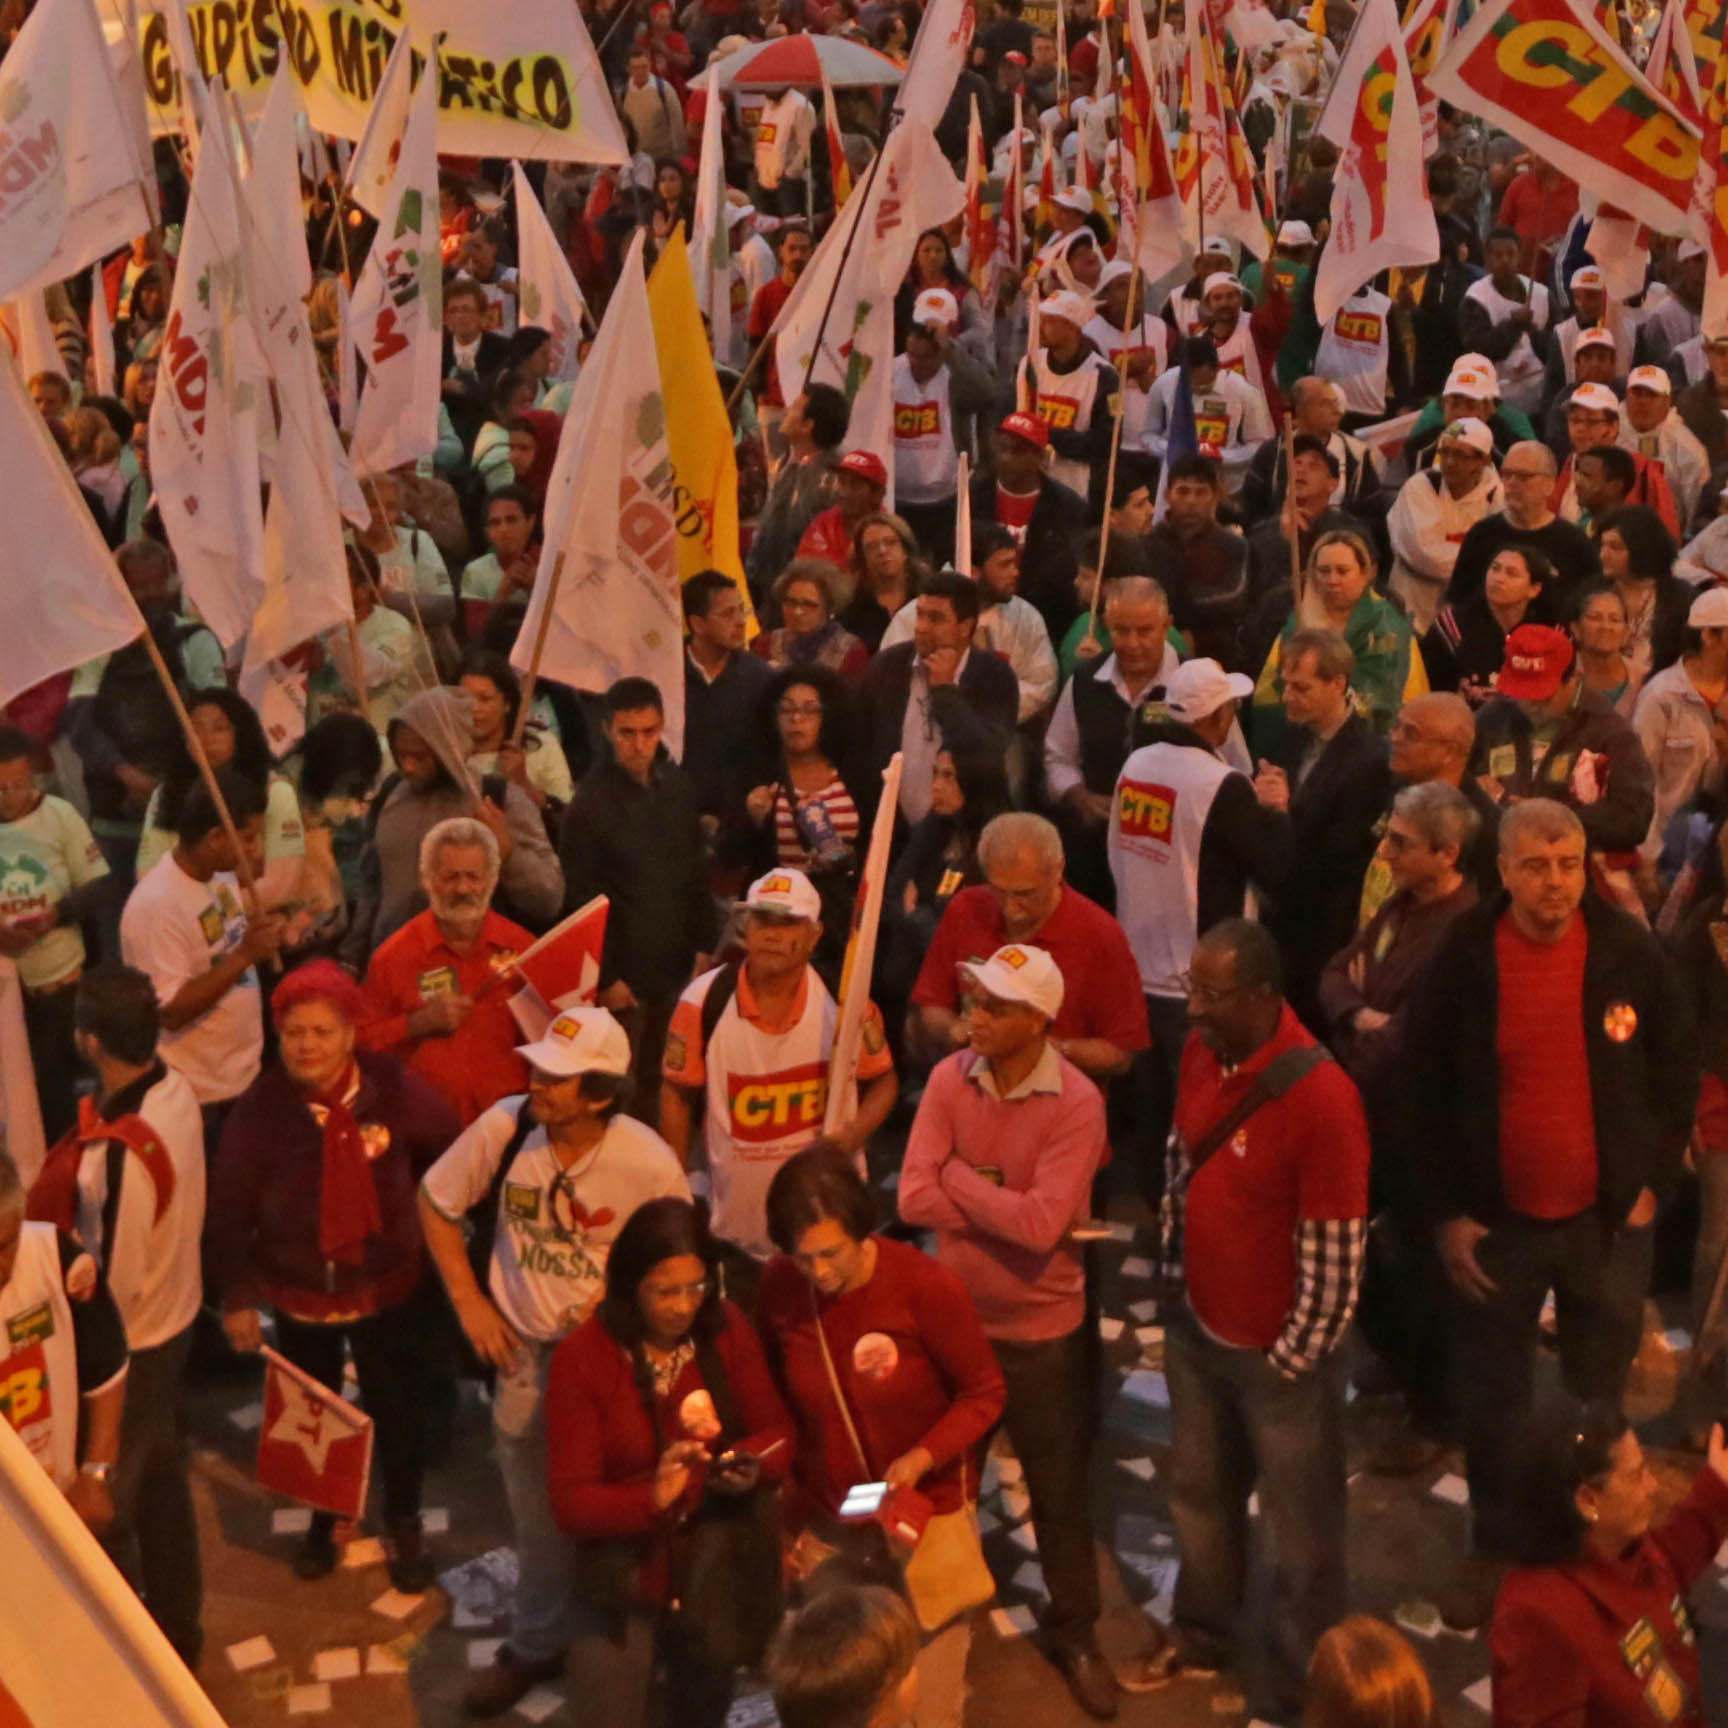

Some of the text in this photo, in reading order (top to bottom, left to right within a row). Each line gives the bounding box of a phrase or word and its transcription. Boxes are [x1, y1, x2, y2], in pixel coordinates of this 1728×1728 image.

[1496, 18, 1702, 183] CTB
[893, 407, 941, 433] CTB
[1119, 787, 1177, 833] CTB
